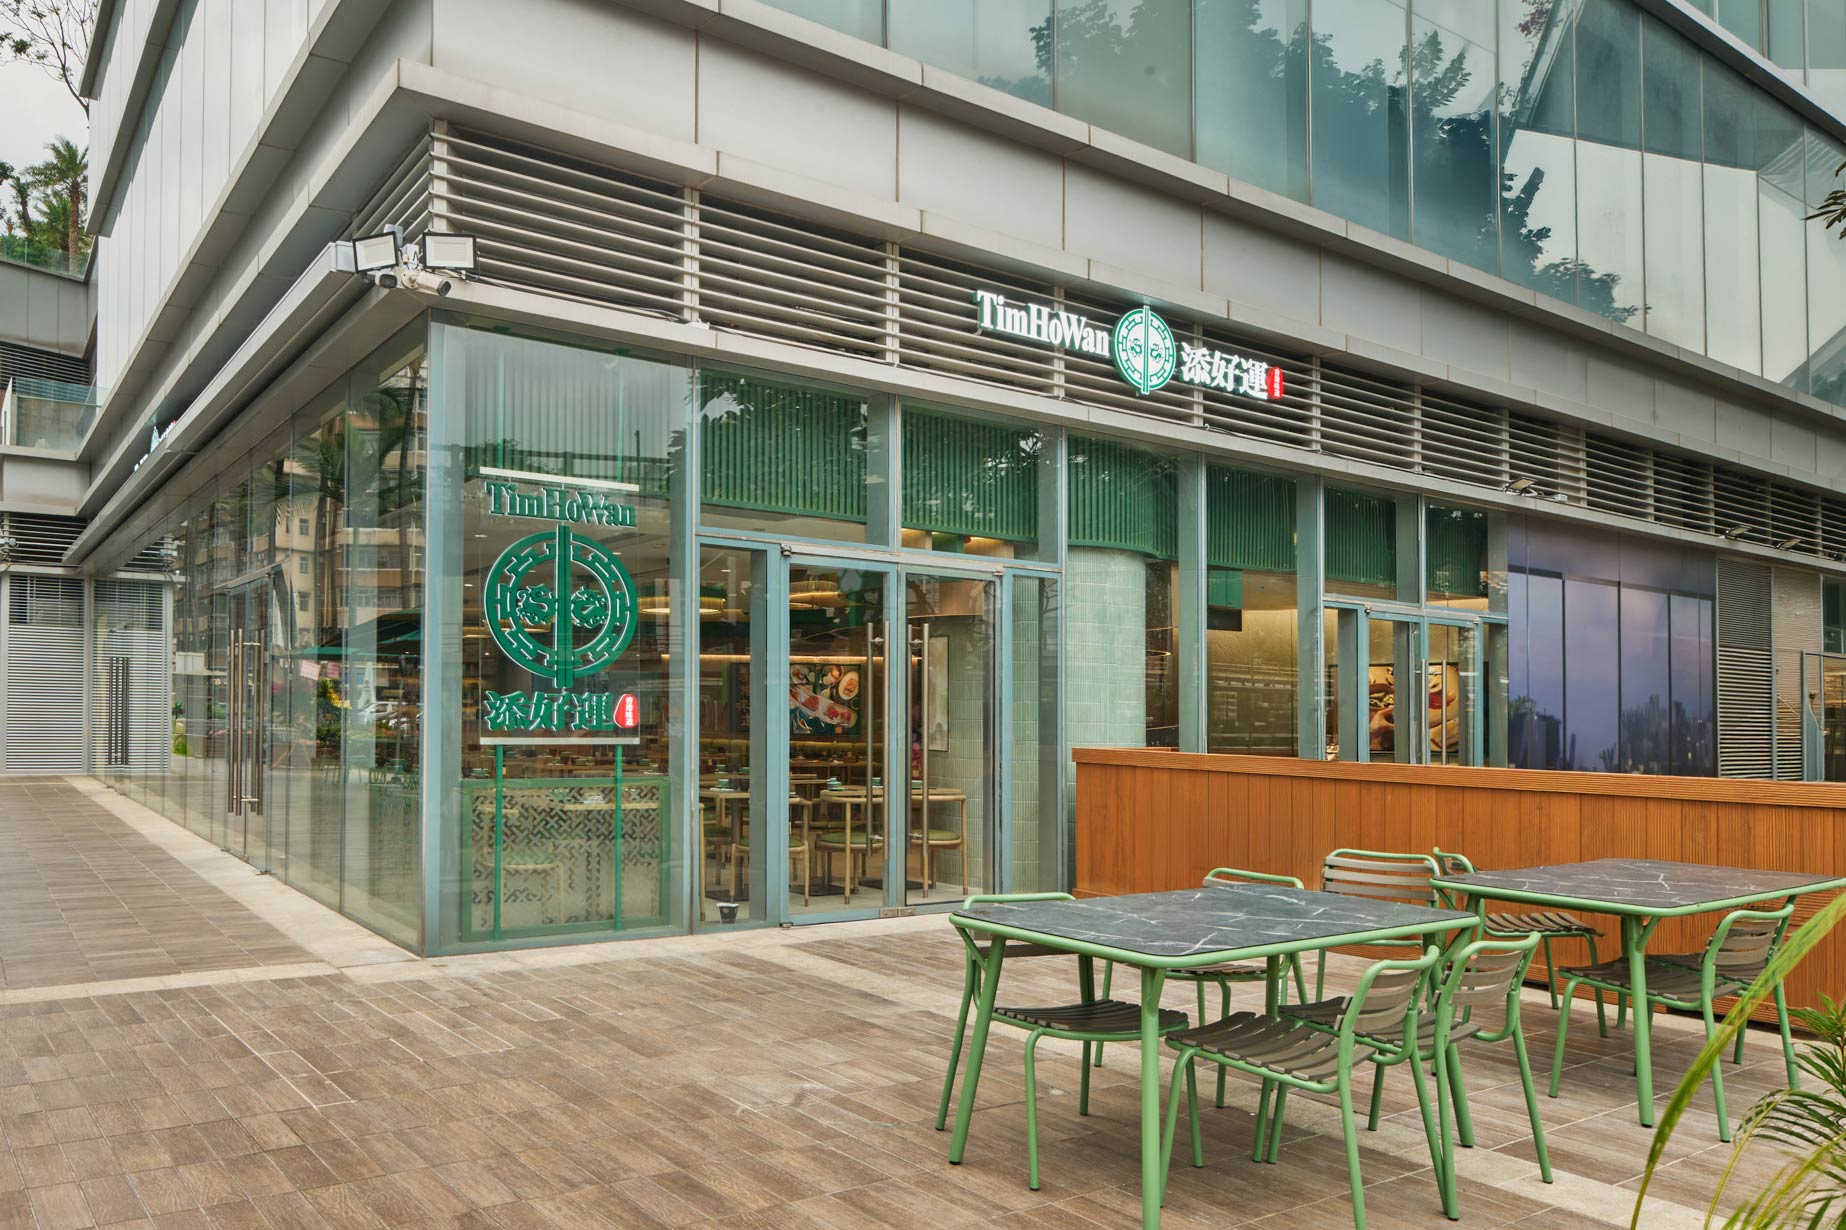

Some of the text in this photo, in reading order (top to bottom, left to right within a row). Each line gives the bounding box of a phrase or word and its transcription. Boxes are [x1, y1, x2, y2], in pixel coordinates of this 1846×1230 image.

[975, 290, 1111, 358] TimHoWan
[1180, 341, 1268, 400] 添好運
[484, 481, 638, 528] TimHoWan
[484, 690, 615, 731] 添好運
